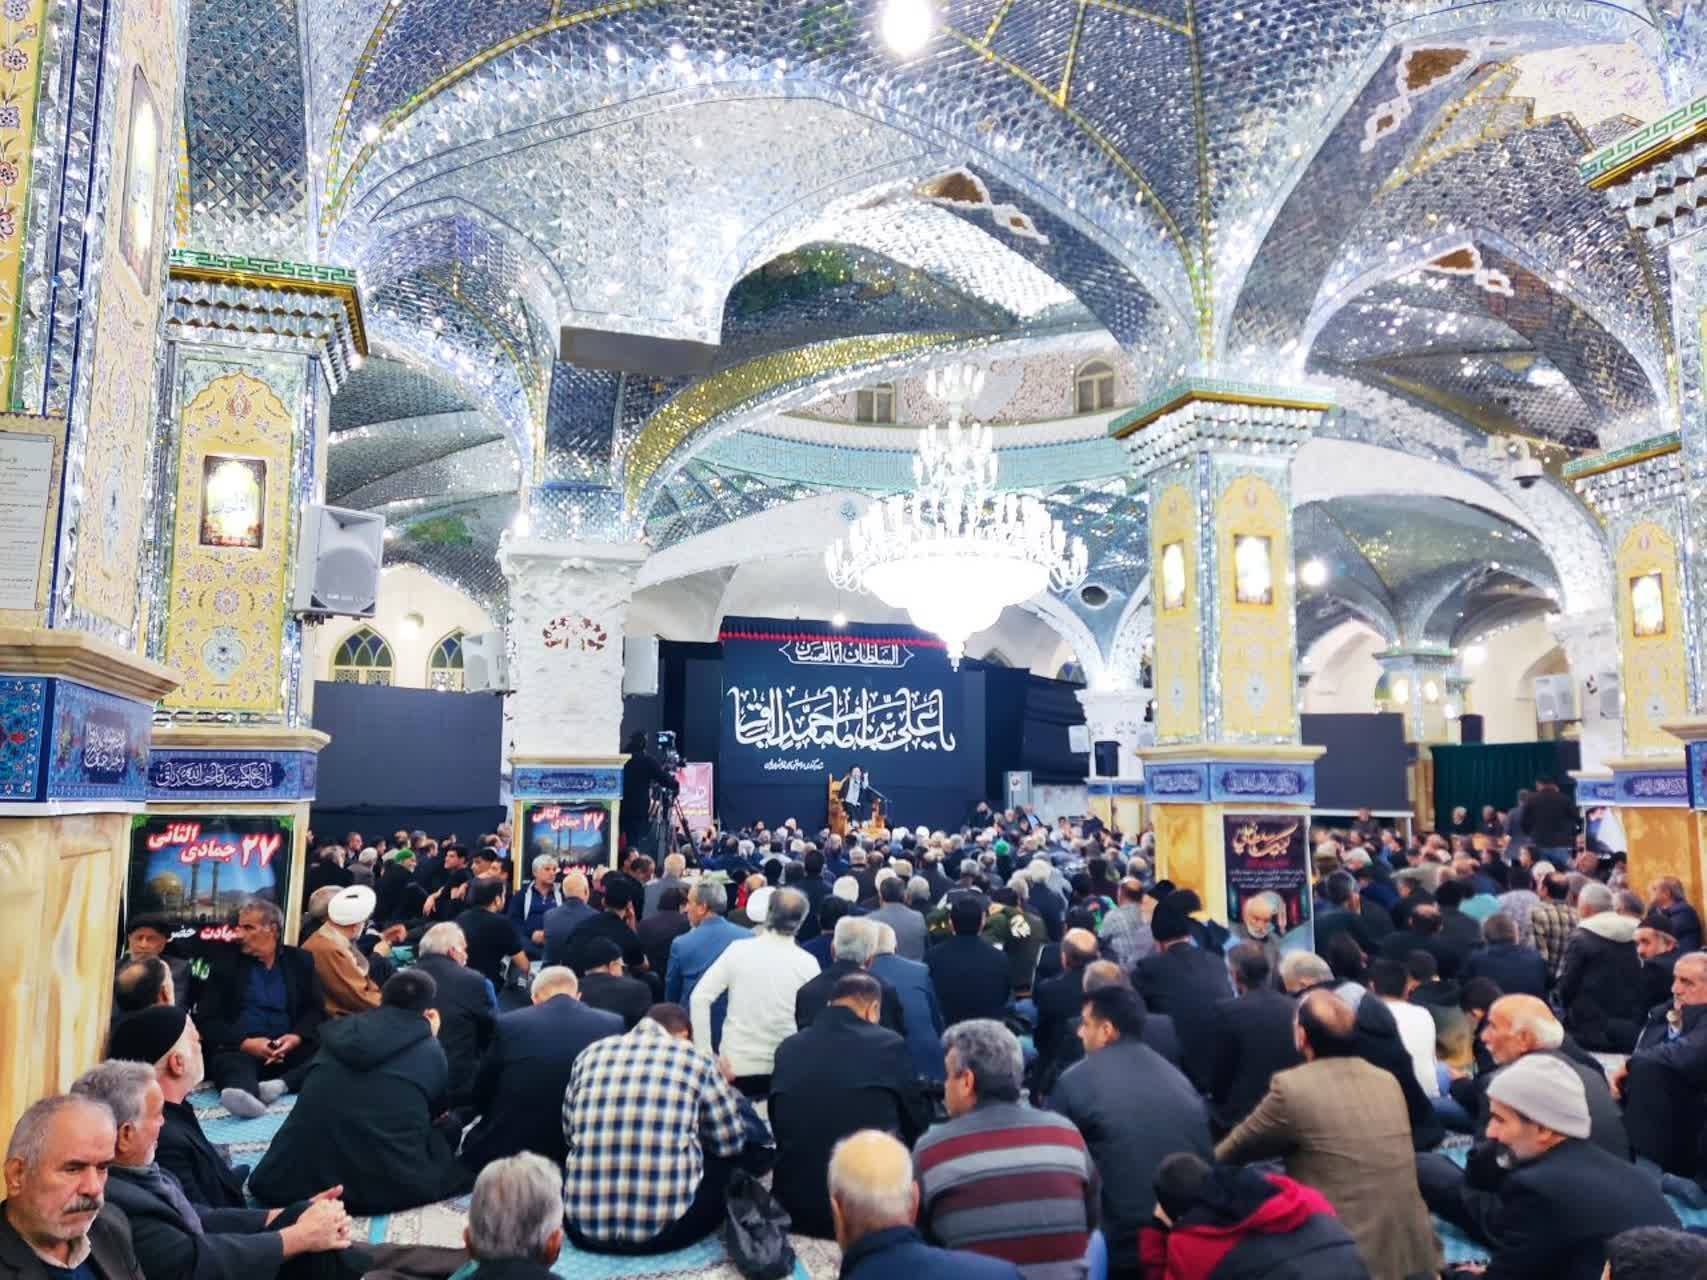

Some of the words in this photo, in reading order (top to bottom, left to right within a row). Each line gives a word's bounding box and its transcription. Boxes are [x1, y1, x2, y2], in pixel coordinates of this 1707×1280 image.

[149, 824, 200, 848] الثانی
[181, 840, 236, 863] جمادی
[241, 835, 280, 867] ۲۷
